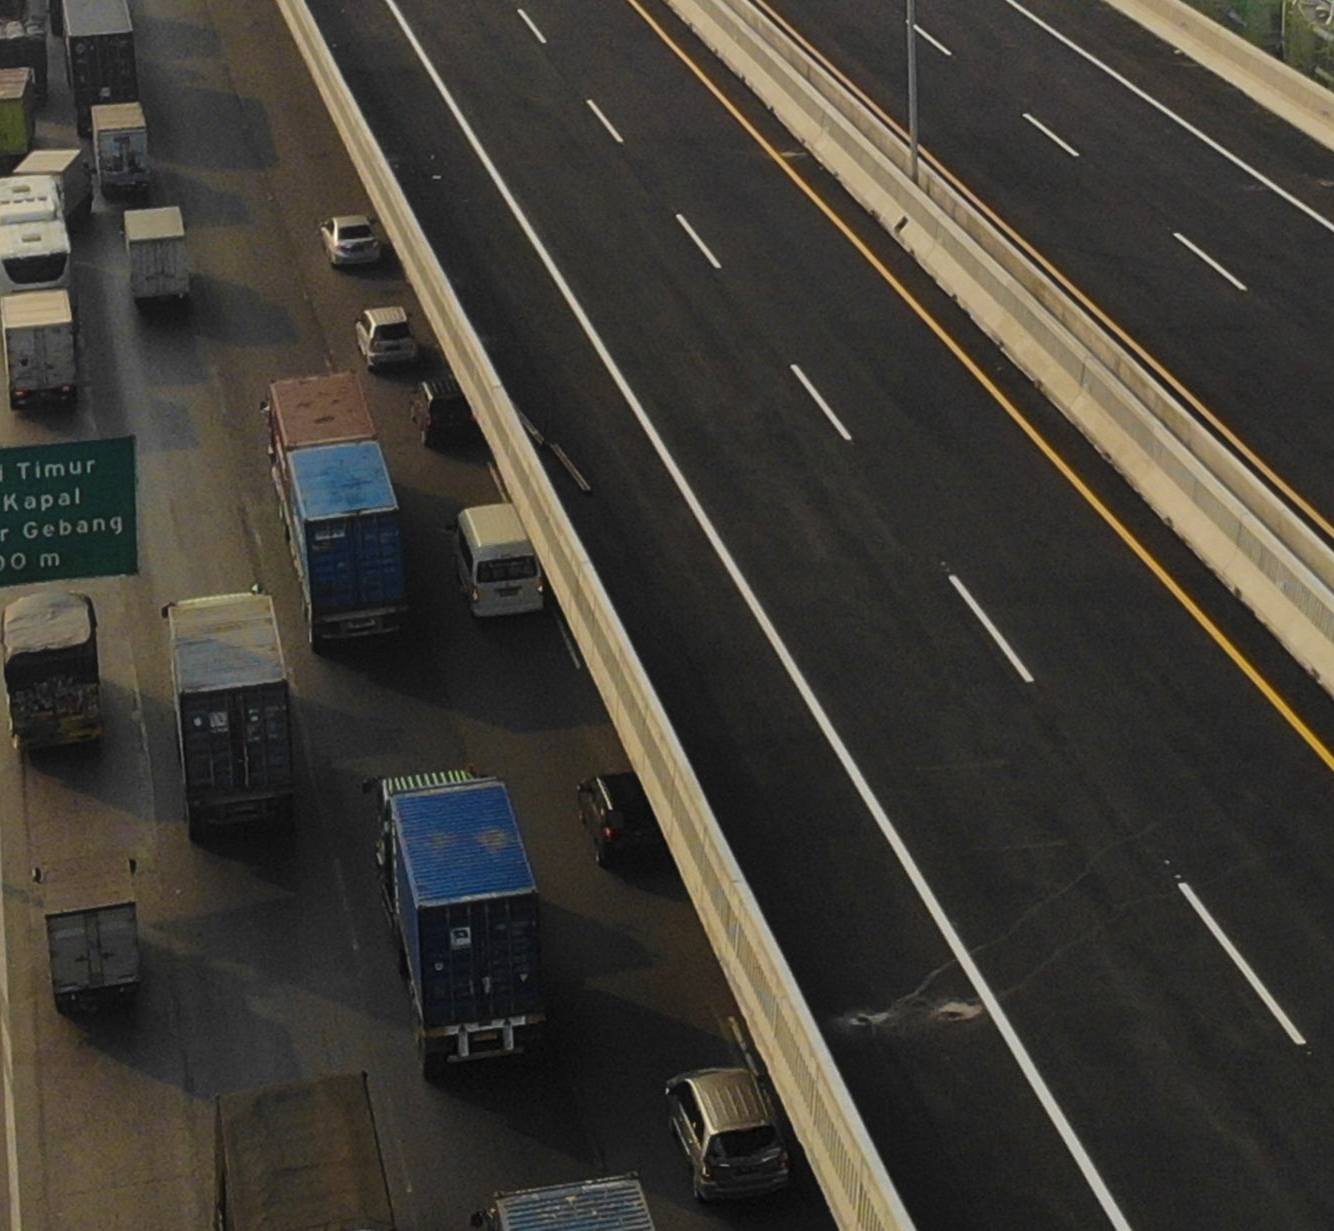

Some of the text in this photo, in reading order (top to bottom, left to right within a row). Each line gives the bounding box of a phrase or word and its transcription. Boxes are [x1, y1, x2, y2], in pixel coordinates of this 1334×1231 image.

[17, 457, 96, 481] Timur
[3, 488, 81, 512] Kapal
[23, 516, 123, 540] Gebang
[40, 552, 60, 567] m
